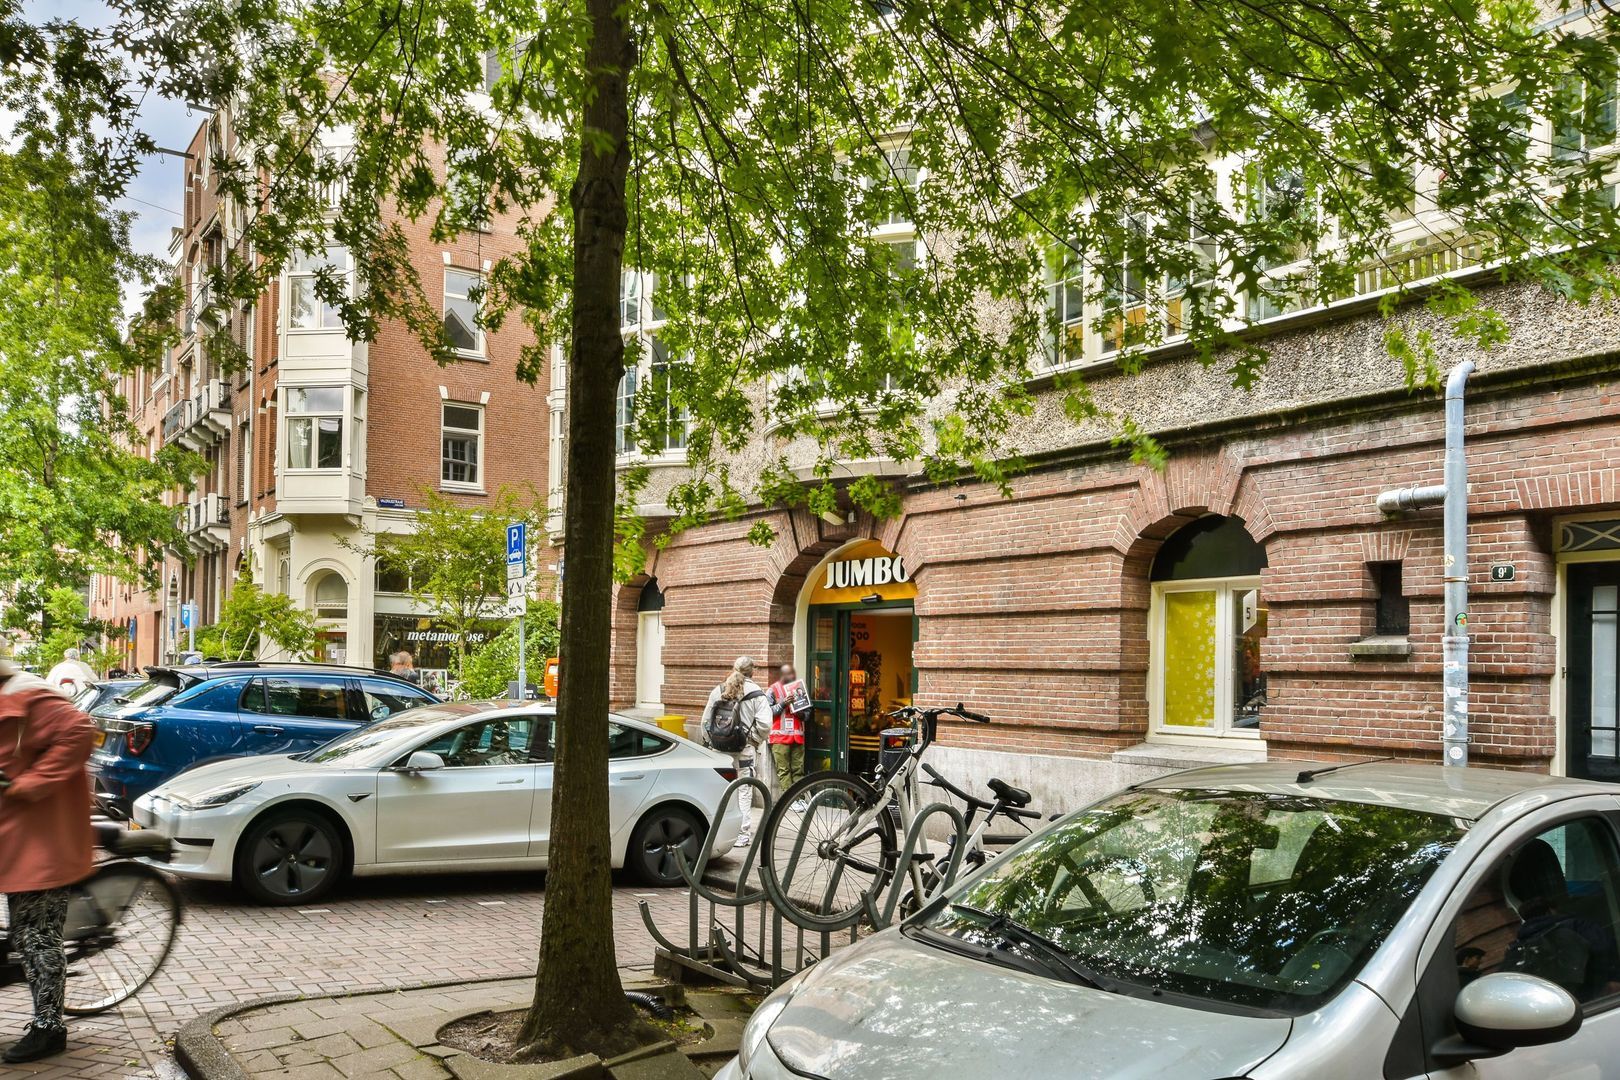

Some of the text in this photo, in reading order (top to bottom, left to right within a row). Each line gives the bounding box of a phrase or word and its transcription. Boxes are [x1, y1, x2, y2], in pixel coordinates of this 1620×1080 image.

[511, 528, 518, 548] P
[823, 555, 910, 589] JUMBO
[1246, 607, 1251, 620] 5
